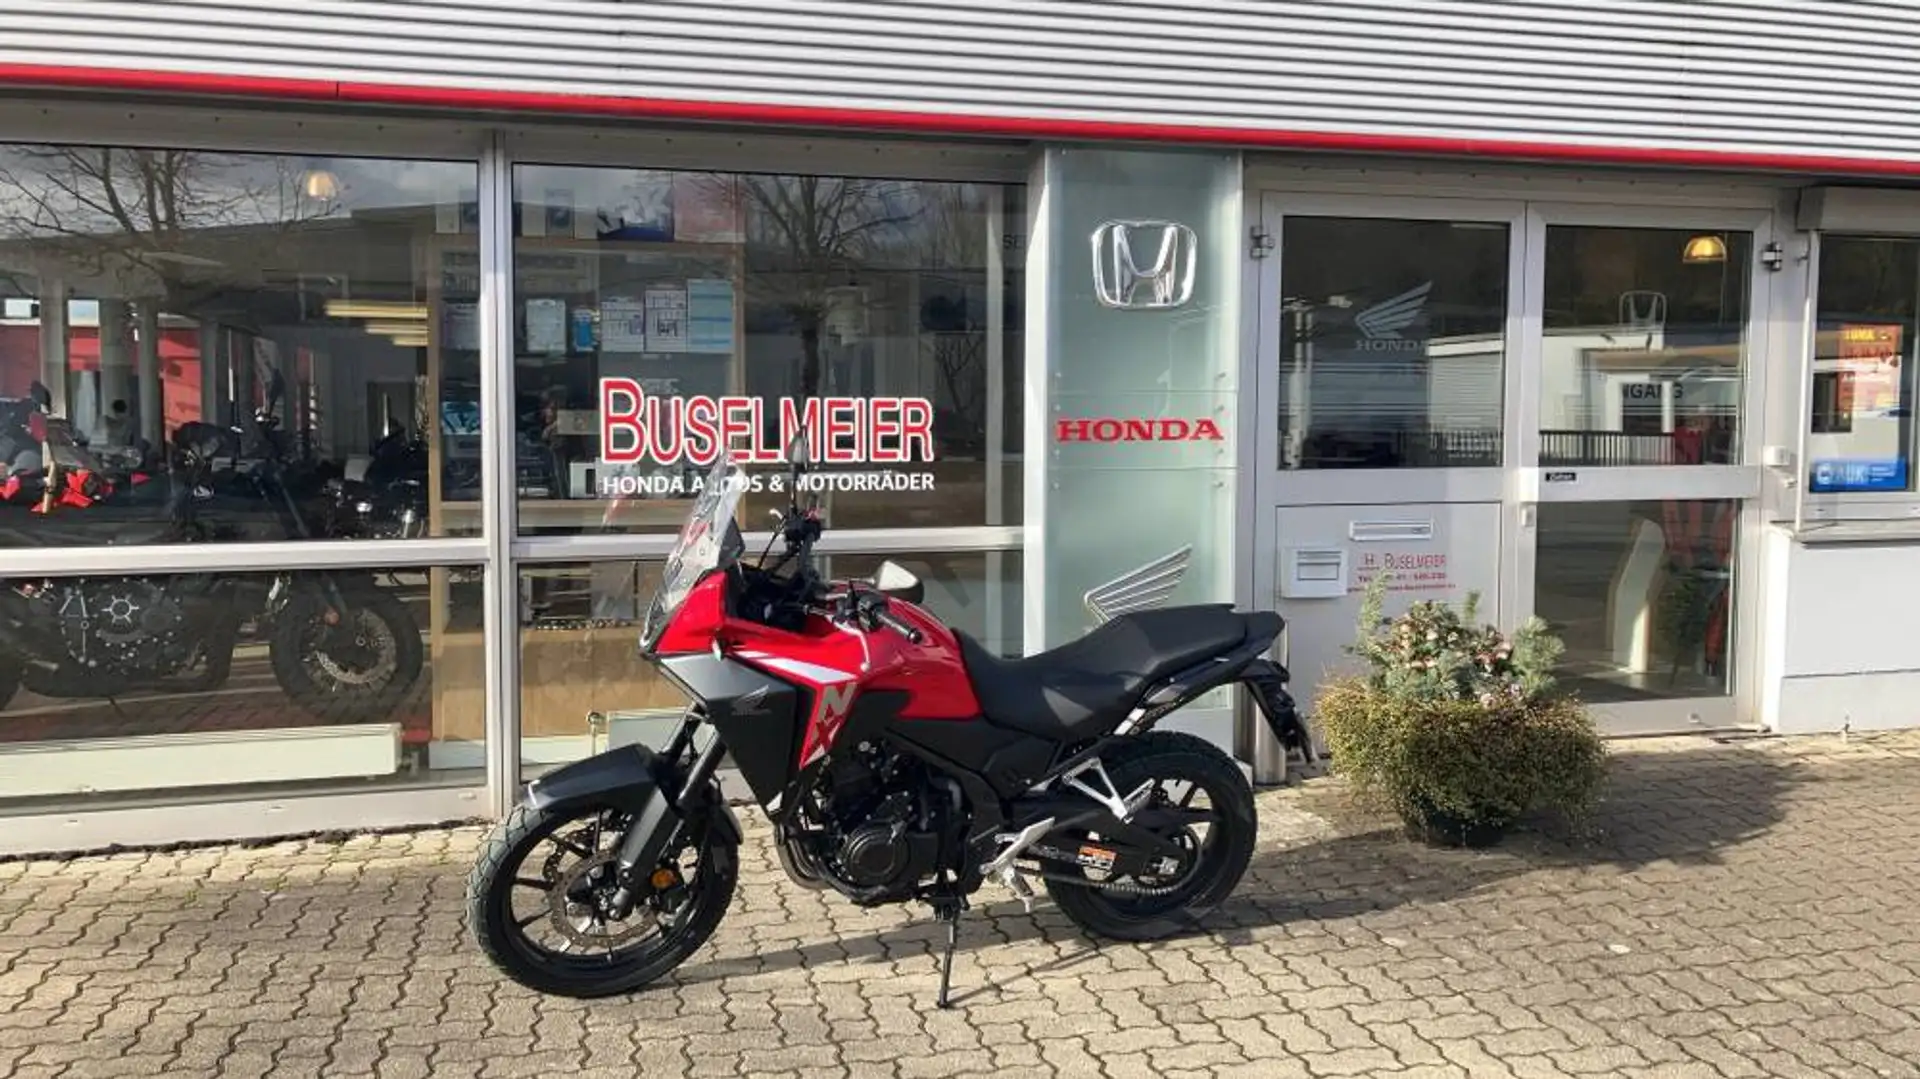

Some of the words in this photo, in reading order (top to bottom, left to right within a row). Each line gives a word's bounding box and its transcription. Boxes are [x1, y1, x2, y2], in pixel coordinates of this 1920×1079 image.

[600, 378, 934, 463] BUSELMEIER
[1057, 420, 1224, 442] HONDA
[604, 475, 684, 495] HONDA
[769, 473, 785, 492] &
[796, 470, 935, 491] MOTORRÄDER
[803, 681, 858, 766] NX
